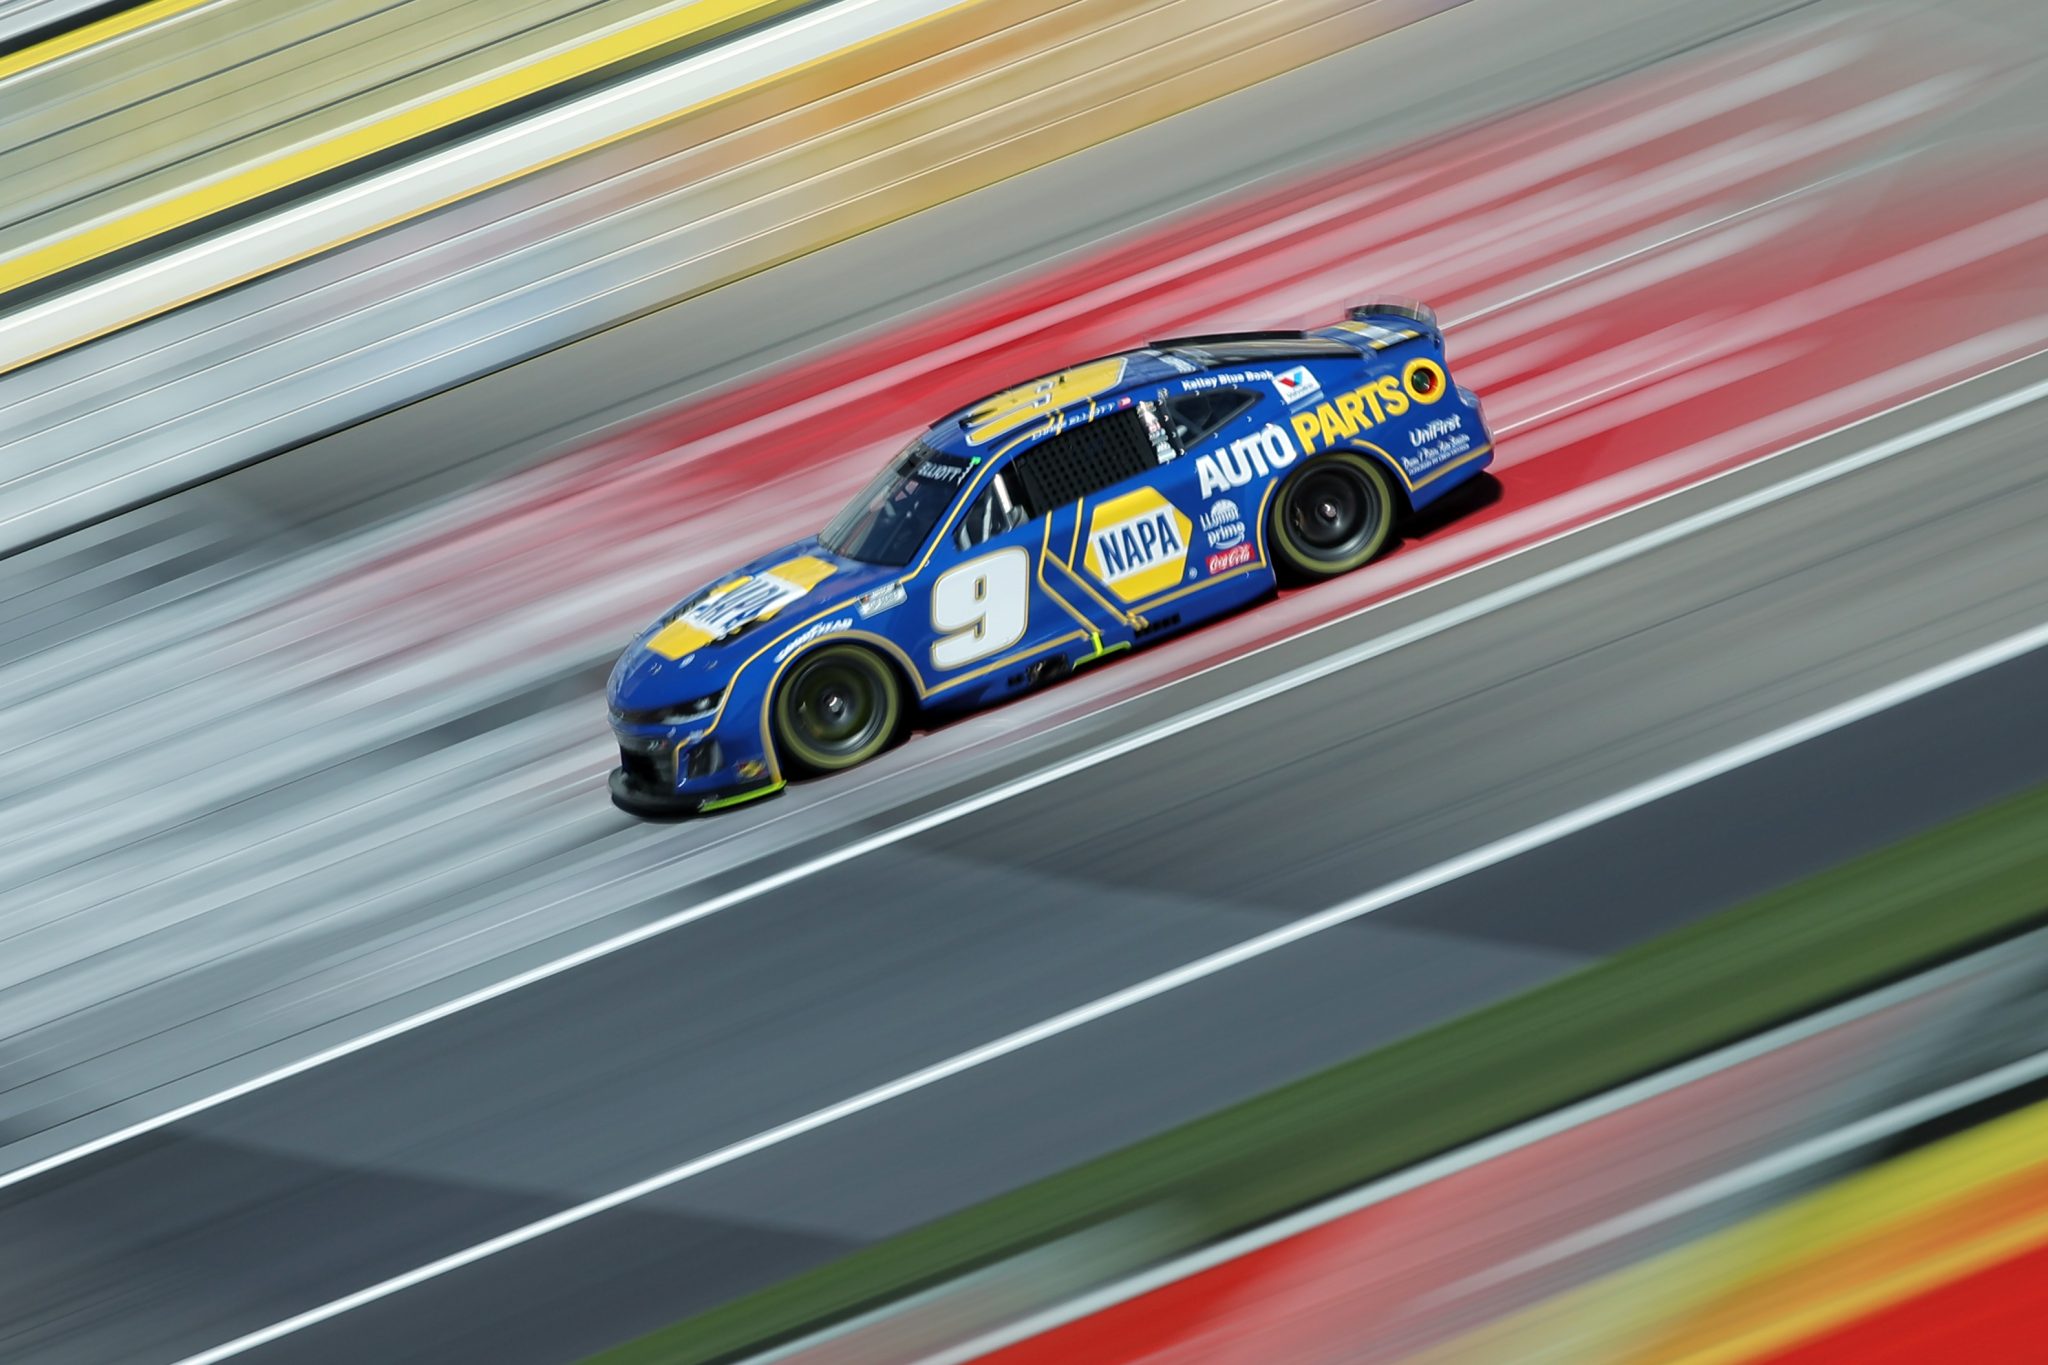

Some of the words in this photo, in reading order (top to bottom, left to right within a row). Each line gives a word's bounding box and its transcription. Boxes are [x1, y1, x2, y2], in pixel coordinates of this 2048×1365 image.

[1181, 377, 1218, 392] Kelley
[1217, 371, 1244, 385] Blue
[1244, 369, 1274, 382] Book
[1195, 423, 1297, 499] AUTO
[1290, 375, 1410, 456] PARTS
[1408, 413, 1461, 447] UniFirst
[918, 461, 962, 482] ELLIOTT
[1098, 512, 1180, 577] NAPA
[1207, 521, 1246, 548] prime
[931, 545, 1030, 671] 9
